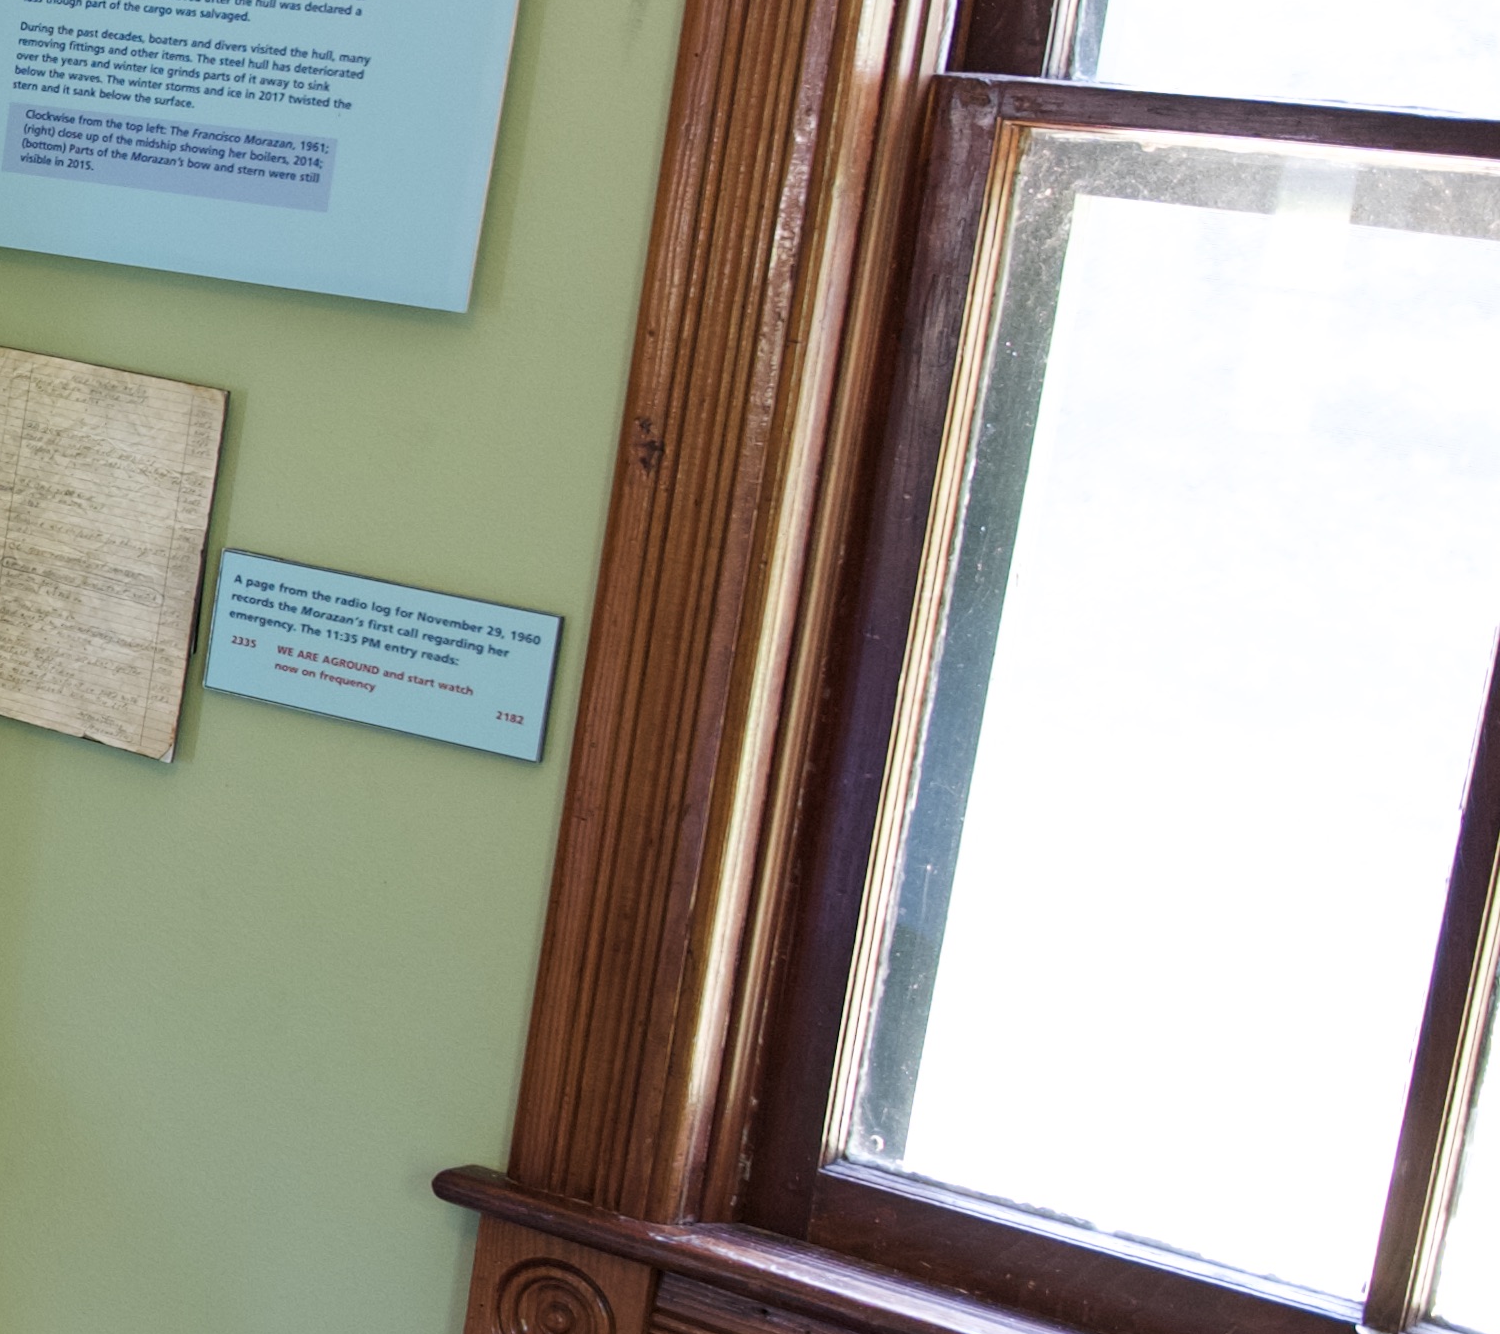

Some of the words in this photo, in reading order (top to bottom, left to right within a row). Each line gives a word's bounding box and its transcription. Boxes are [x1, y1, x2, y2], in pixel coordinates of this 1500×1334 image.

[25, 109, 76, 125] Clockwise
[78, 114, 103, 127] from
[105, 118, 123, 130] the
[125, 121, 144, 134] top
[170, 125, 190, 138] The
[191, 128, 242, 144] Francisco
[243, 134, 296, 151] Morazan,
[300, 140, 329, 155] 1961;
[231, 593, 275, 609] records
[277, 601, 298, 614] the
[300, 605, 365, 628] Morazan's
[367, 618, 394, 634] first
[396, 627, 419, 639] call
[421, 633, 485, 656] regarding
[487, 643, 510, 658] her
[233, 574, 243, 585] A
[245, 578, 276, 592] page
[278, 582, 309, 598] from
[311, 590, 332, 603] the
[334, 596, 368, 610] radio
[371, 601, 392, 618] log
[394, 606, 414, 619] for
[416, 611, 484, 634] November
[486, 625, 505, 640] 29,
[510, 630, 542, 646] 1960
[228, 610, 297, 633] emergency.
[300, 623, 322, 637] The
[326, 628, 358, 645] 11:35
[361, 636, 382, 649] PM
[383, 643, 418, 659] entry
[420, 651, 460, 666] reads:
[230, 635, 257, 649] 2335
[274, 662, 299, 674] now
[301, 669, 317, 678] on
[319, 670, 377, 693] frequency
[277, 645, 294, 657] WE
[296, 649, 319, 663] ARE
[321, 655, 380, 675] AGROUND
[382, 669, 405, 681] and
[407, 675, 435, 688] start
[437, 682, 474, 696] watch
[495, 710, 525, 726] 2182
